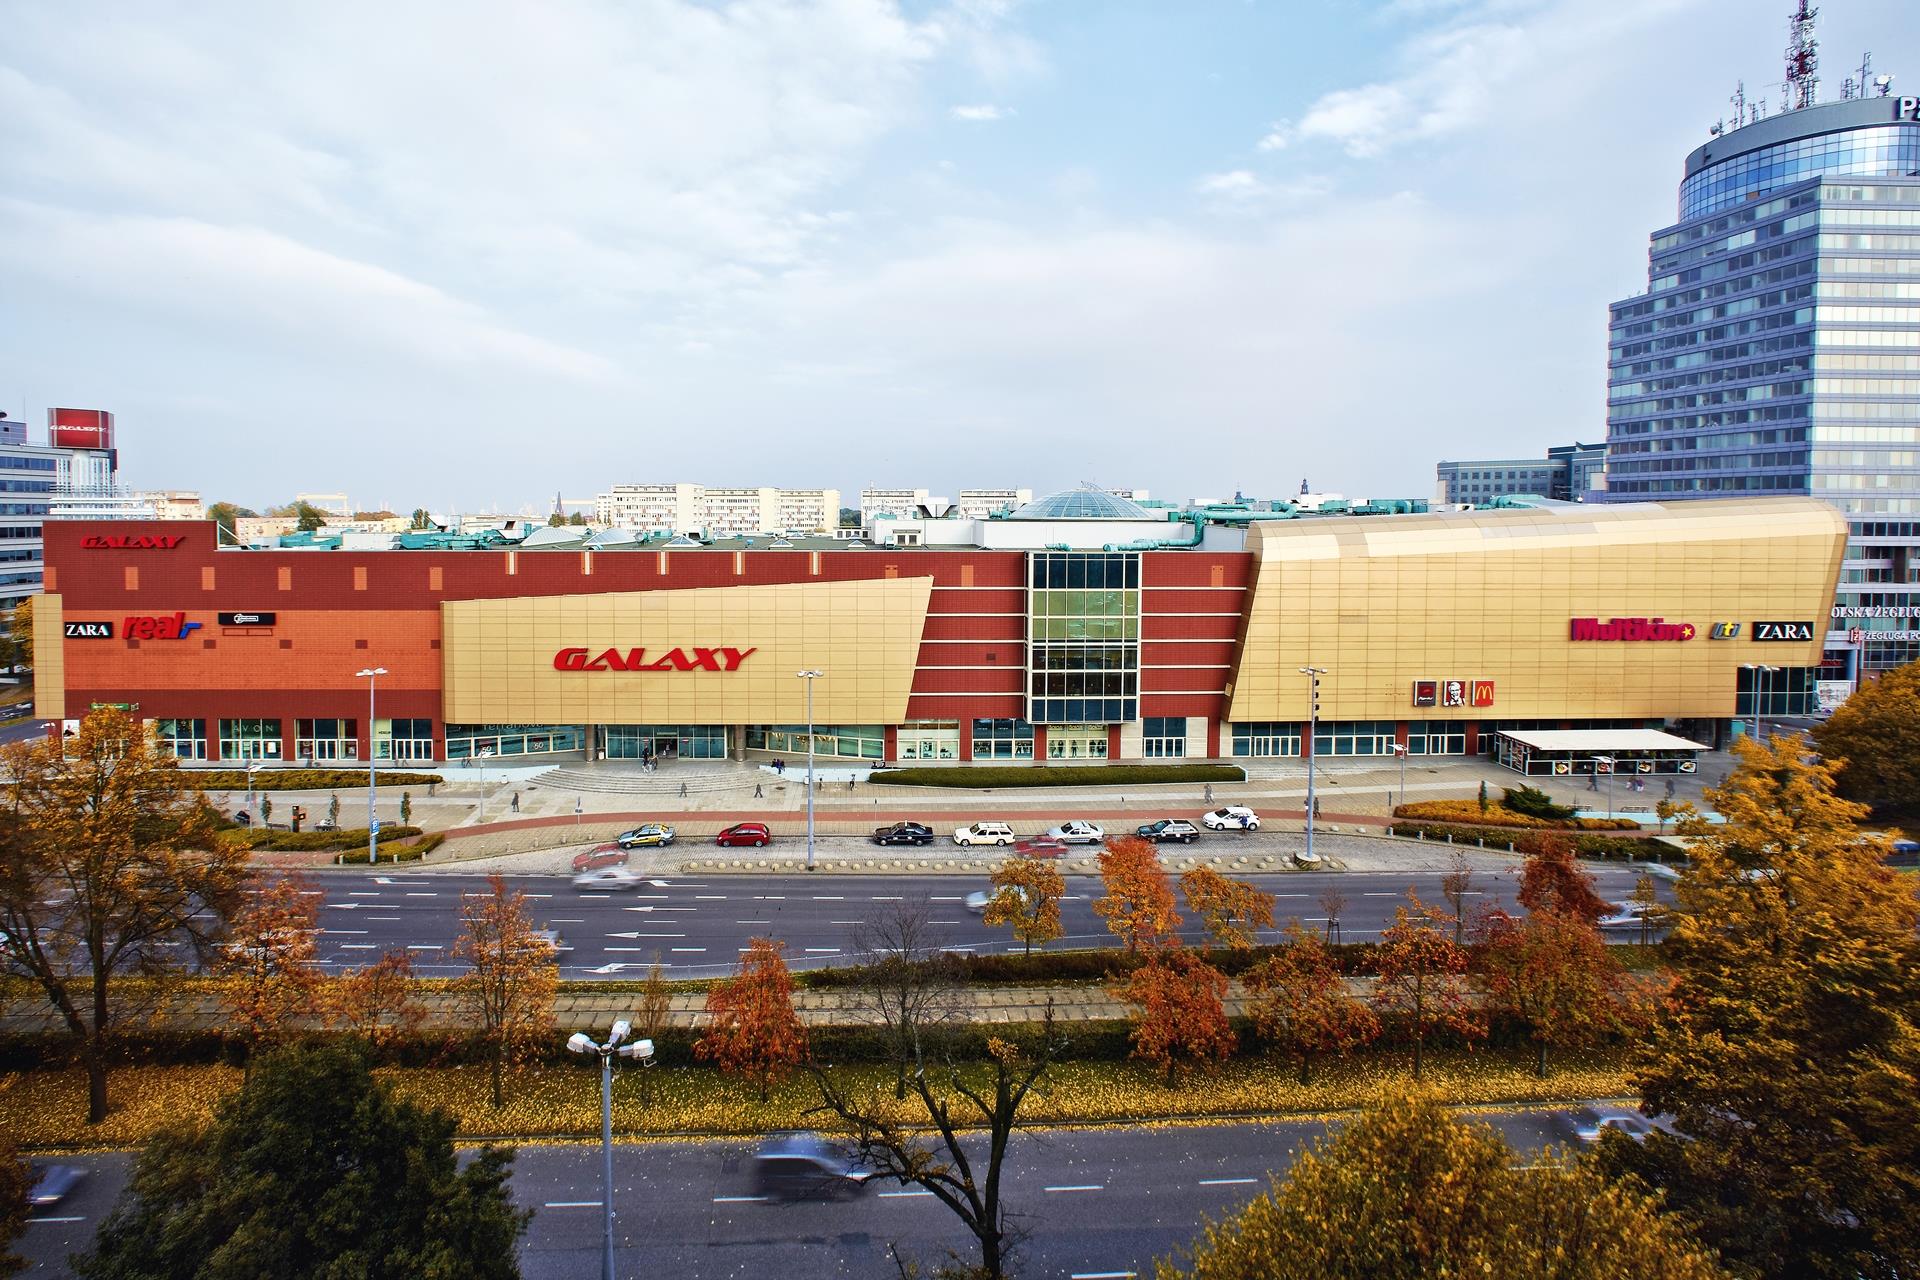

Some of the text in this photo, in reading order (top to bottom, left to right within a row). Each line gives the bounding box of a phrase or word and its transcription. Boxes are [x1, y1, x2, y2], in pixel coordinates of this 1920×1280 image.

[80, 536, 186, 549] GALAXY
[66, 624, 110, 636] ZARA
[1571, 617, 1696, 641] Multikino
[1758, 624, 1813, 639] ZARA
[553, 647, 758, 671] GALAXY
[234, 725, 273, 733] AVON
